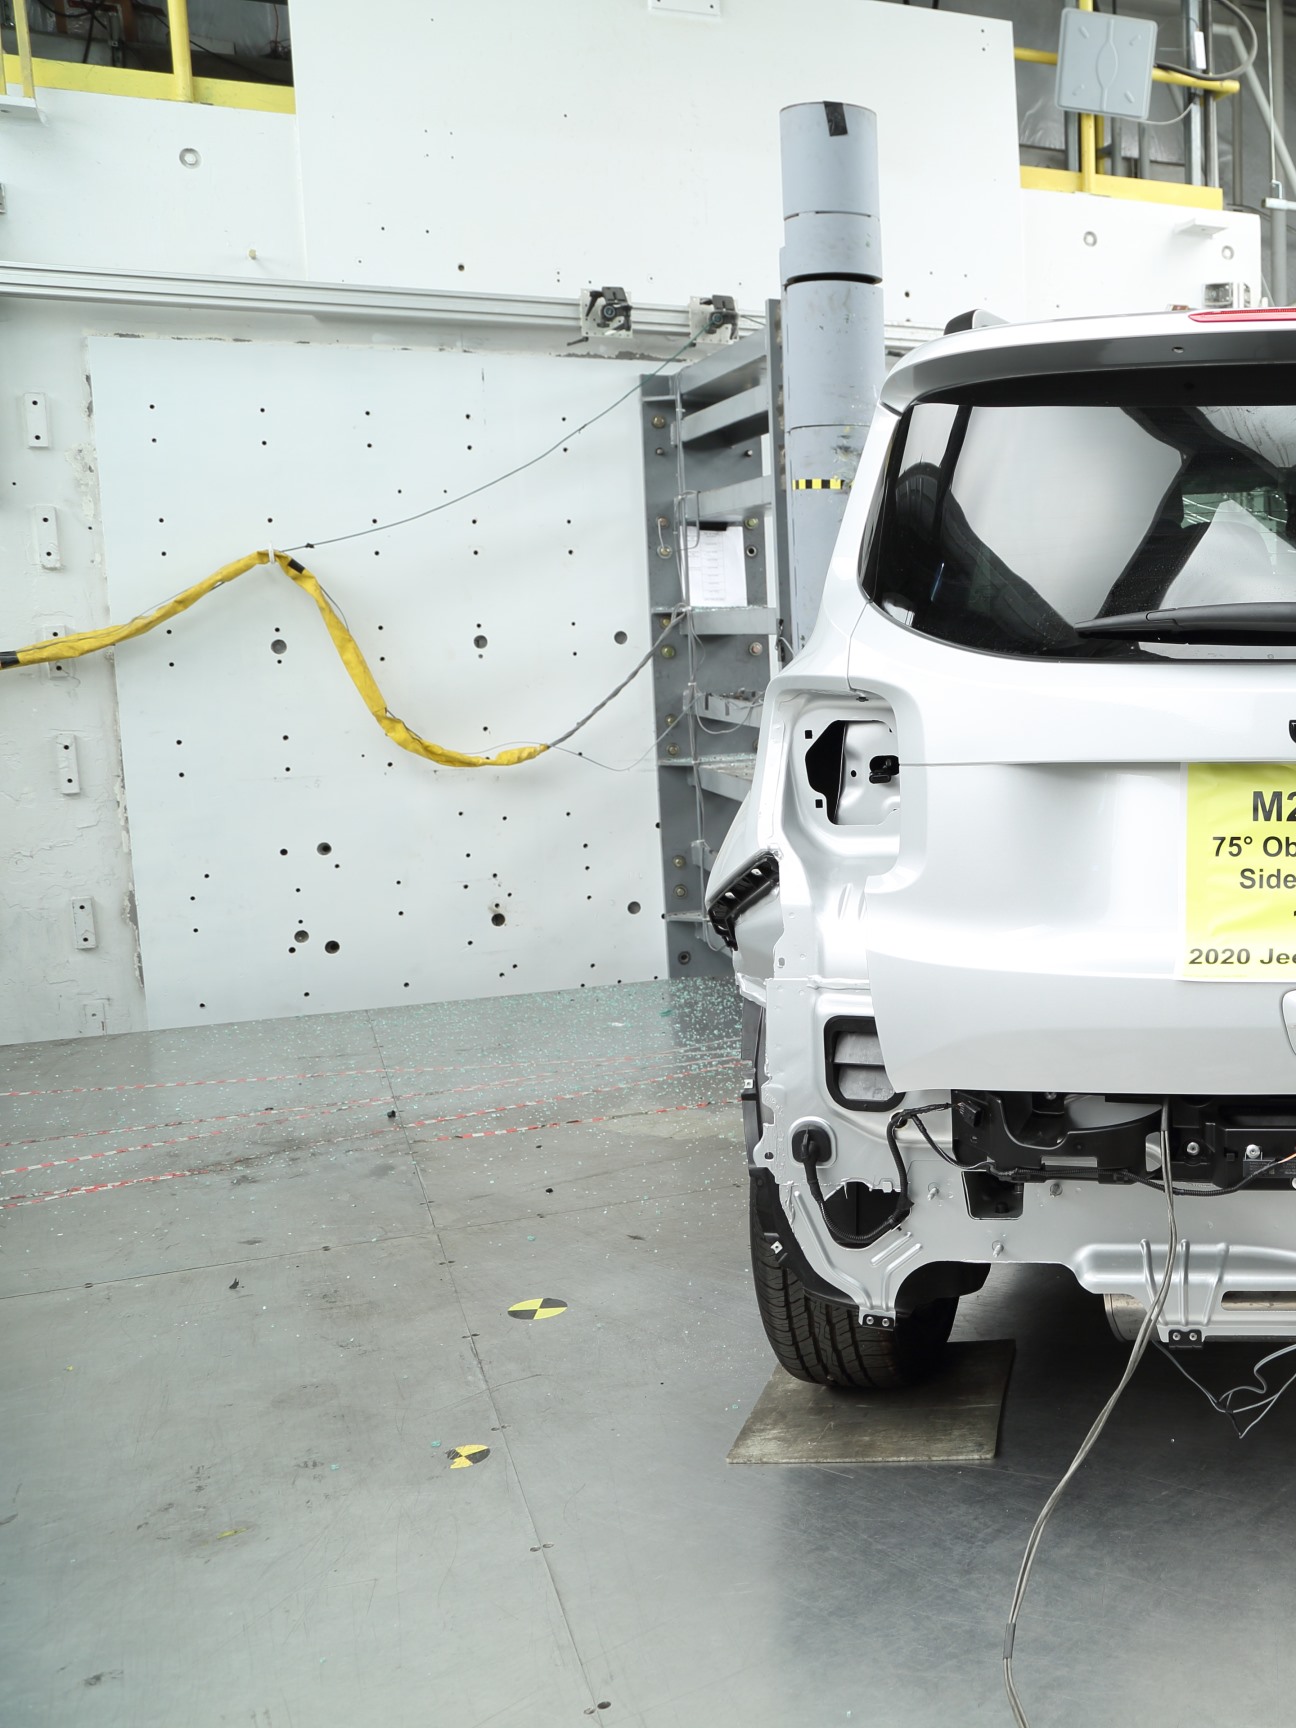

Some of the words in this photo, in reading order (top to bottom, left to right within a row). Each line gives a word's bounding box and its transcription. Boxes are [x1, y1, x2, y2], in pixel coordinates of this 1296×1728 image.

[1212, 836, 1253, 857] 75°
[1239, 868, 1296, 890] Side
[1189, 948, 1250, 965] 2020
